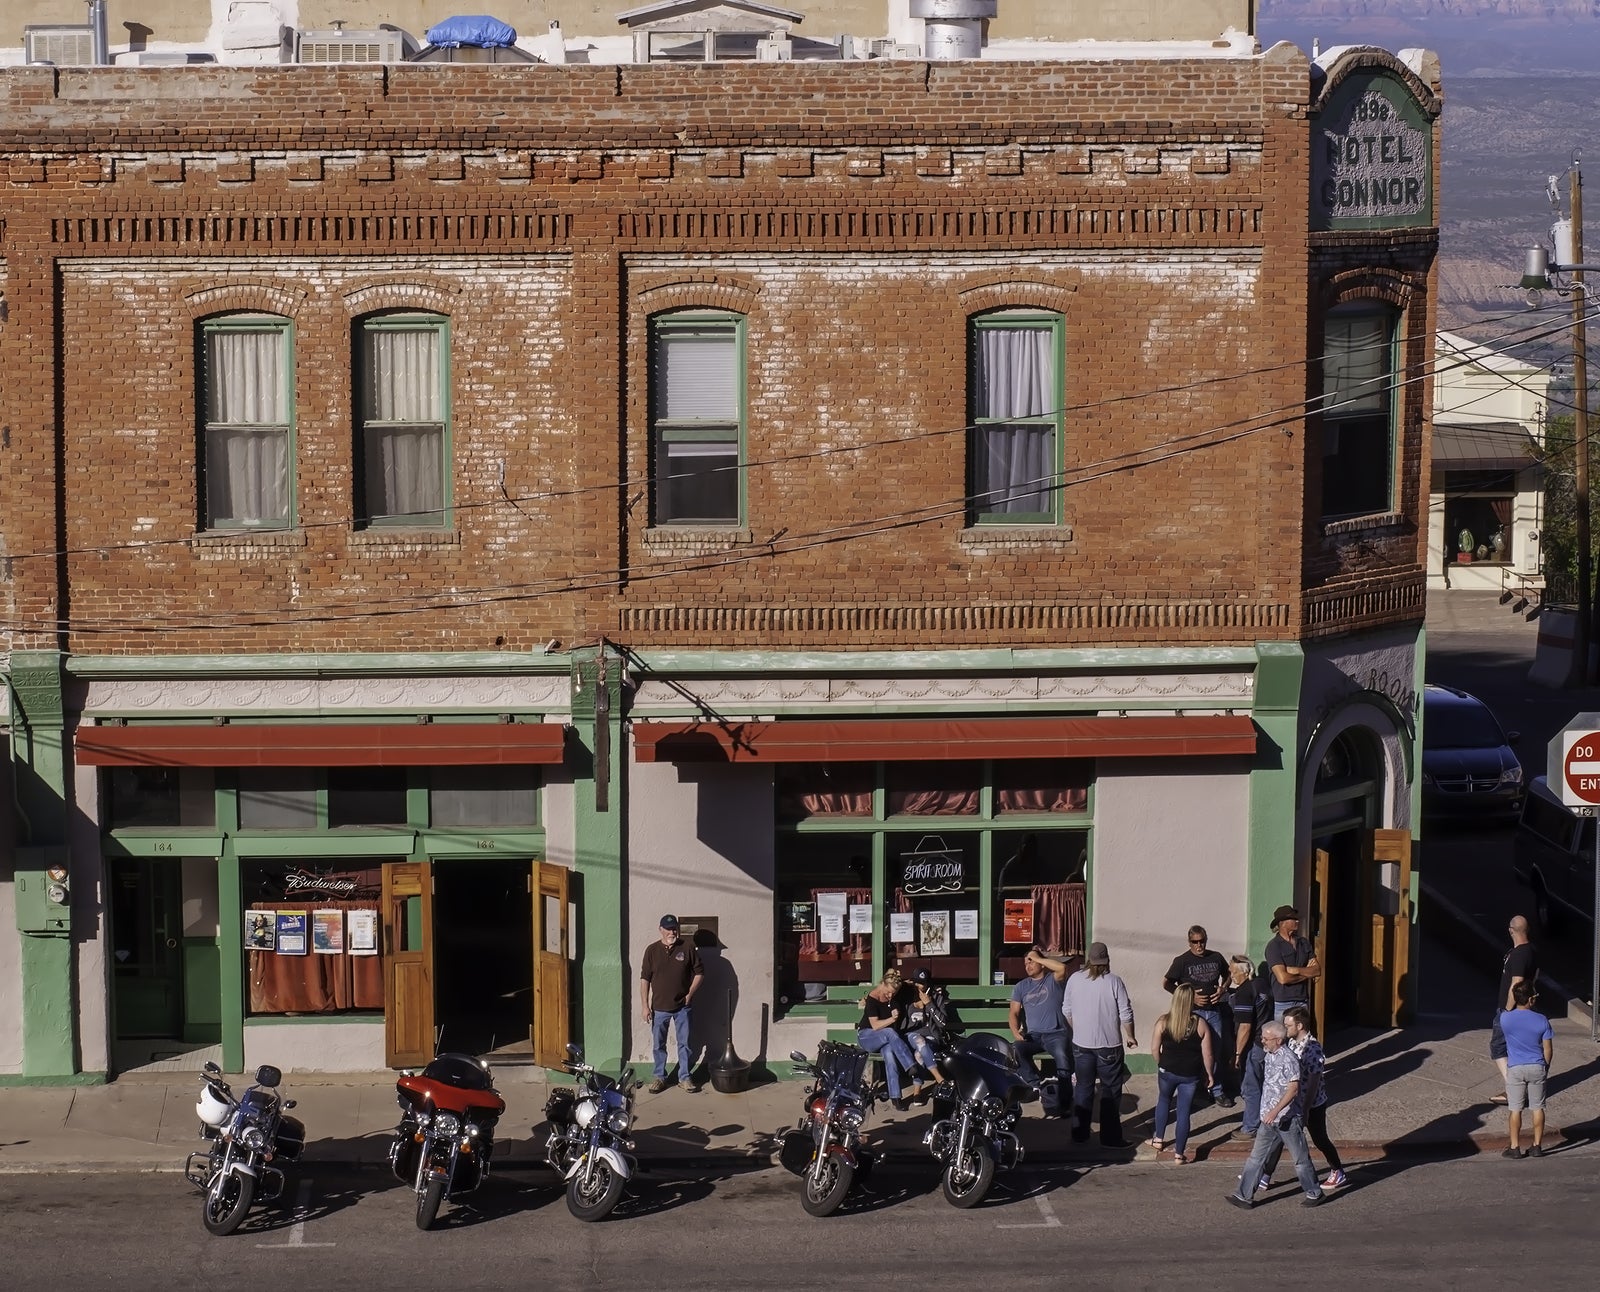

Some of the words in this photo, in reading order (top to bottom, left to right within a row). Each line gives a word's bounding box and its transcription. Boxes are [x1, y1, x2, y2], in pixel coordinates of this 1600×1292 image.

[1327, 135, 1413, 165] HOTEL
[1321, 177, 1420, 208] CONNOR
[1368, 668, 1409, 711] ROOM
[1576, 746, 1593, 758] DO
[154, 842, 173, 852] 164
[904, 863, 931, 881] SPIRIT
[934, 862, 962, 878] ROOM
[285, 874, 357, 890] Budweiser
